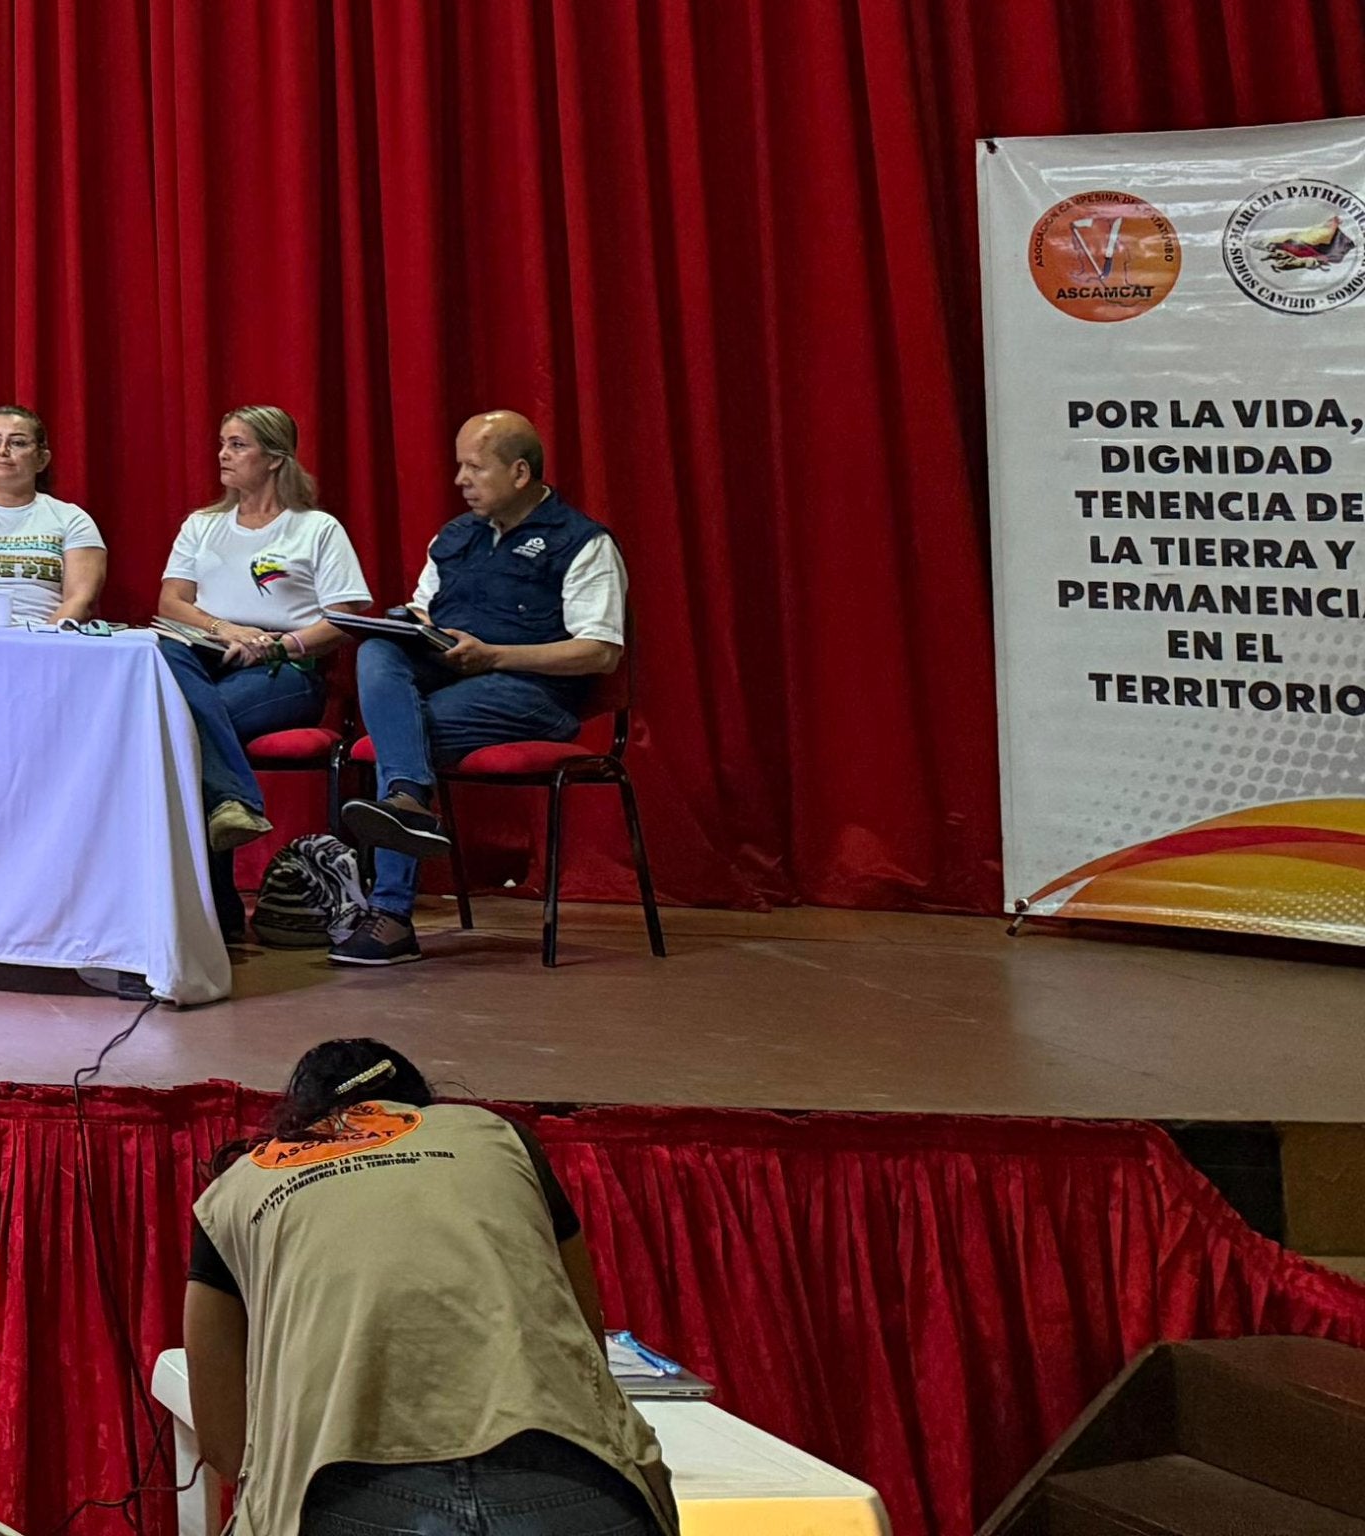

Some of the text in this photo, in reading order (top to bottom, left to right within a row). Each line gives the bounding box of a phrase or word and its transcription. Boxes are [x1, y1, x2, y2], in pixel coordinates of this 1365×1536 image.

[1230, 190, 1283, 241] MARCHA
[1056, 286, 1155, 299] ASCAMCAT
[1257, 286, 1316, 309] CAMBIO
[1068, 399, 1364, 435] POR LA VIDA,
[1101, 445, 1332, 474] DIGNIDAD
[1075, 490, 1365, 522] TENENCIA DE
[1089, 535, 1356, 570] LA TIERRA Y
[1058, 580, 1365, 619] PERMANENCI
[1168, 630, 1283, 663] EN EL
[1088, 672, 1365, 716] TERRITORIO
